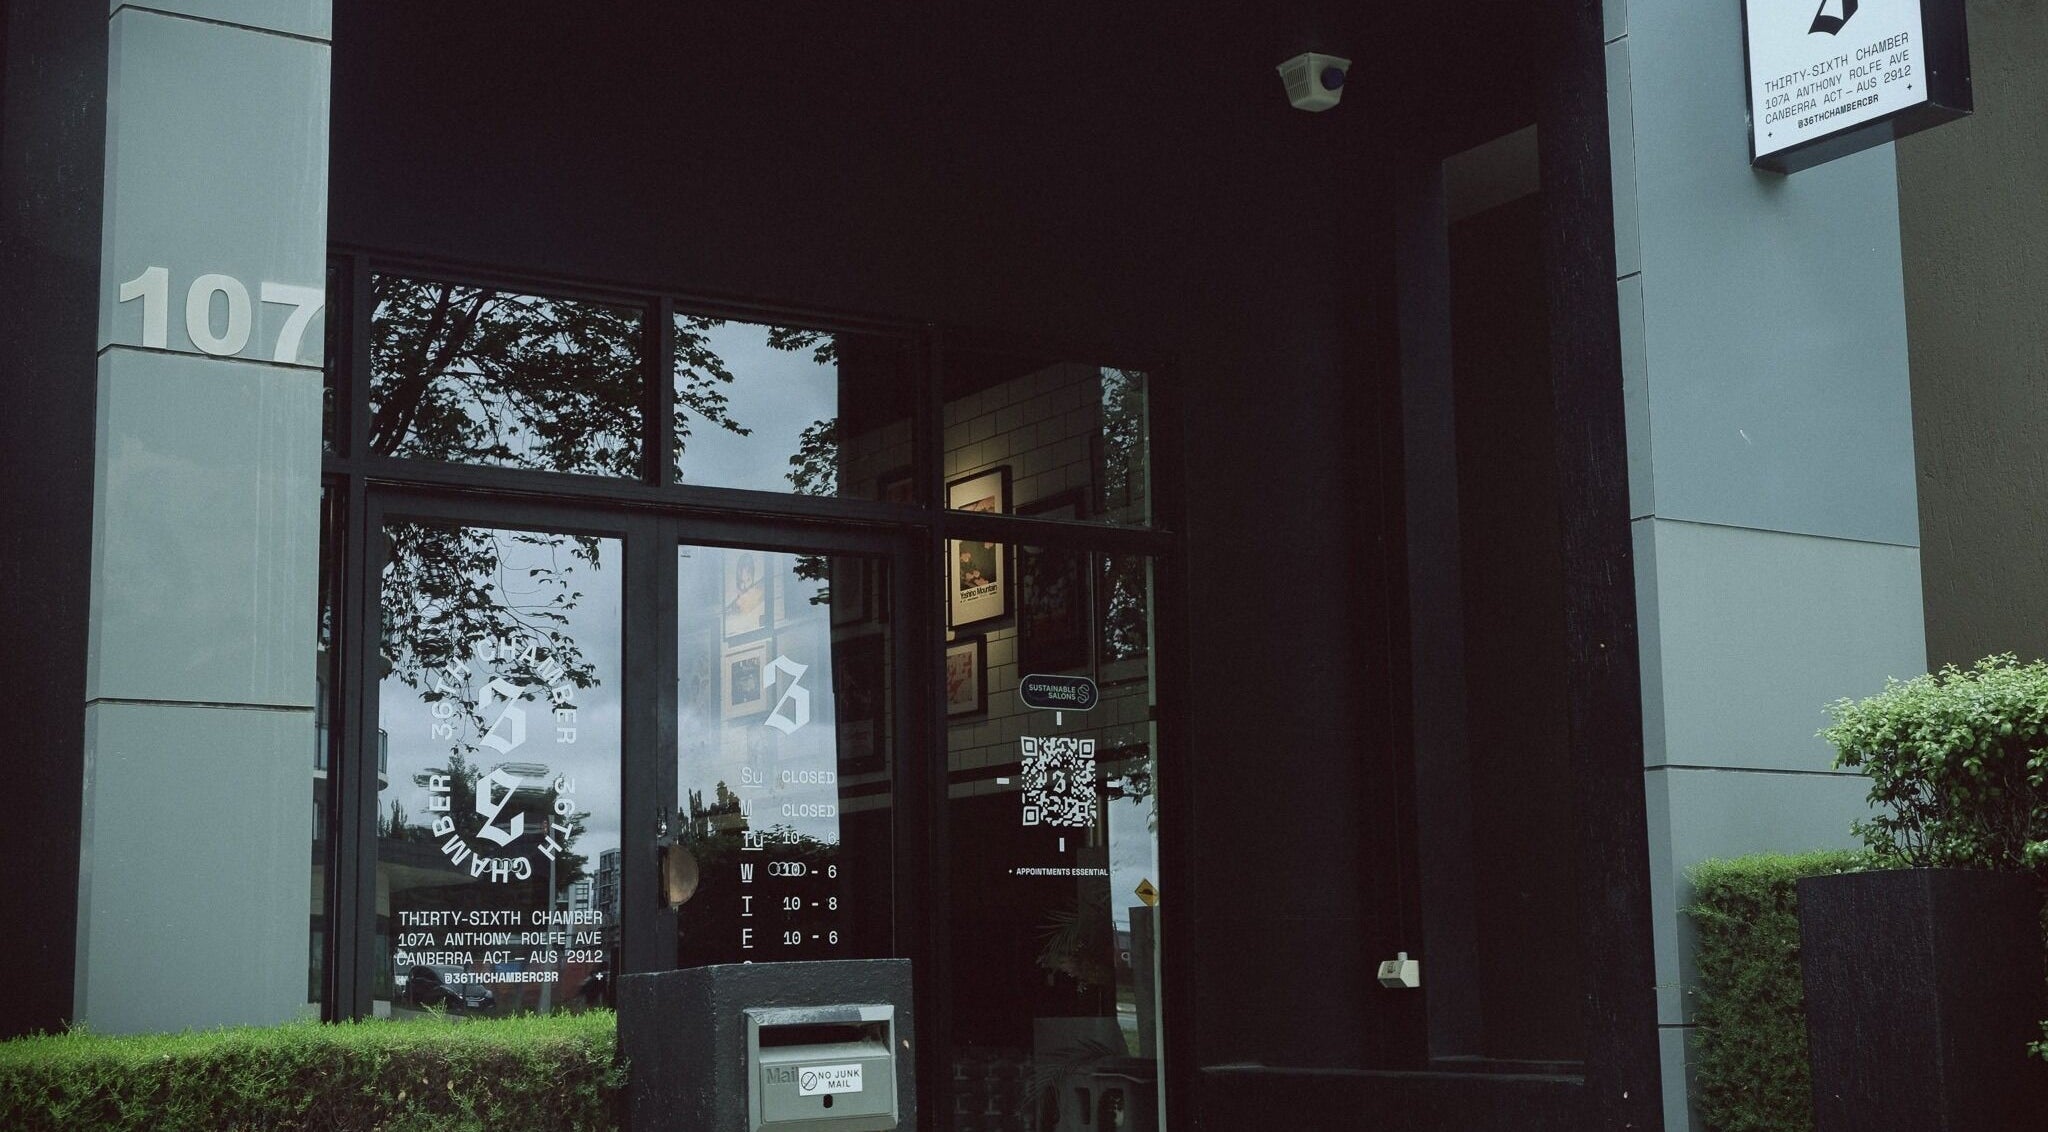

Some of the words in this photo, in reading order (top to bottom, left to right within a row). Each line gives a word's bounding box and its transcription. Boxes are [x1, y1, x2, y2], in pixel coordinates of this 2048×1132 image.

[1764, 54, 1848, 93] THIRTY-SIXTH
[1855, 32, 1909, 61] CHAMBER
[1765, 94, 1790, 110] 107A
[1796, 74, 1842, 99] ANTHONY
[1849, 60, 1882, 80] ROLFE
[1889, 50, 1909, 67] AVE
[1765, 99, 1817, 125] CANBERRA
[1823, 90, 1842, 104] ACT
[1856, 77, 1877, 93] AUS
[1884, 65, 1911, 84] 2912
[1798, 94, 1879, 129] @36THCHAMBERCBR
[119, 266, 325, 363] 107
[477, 636, 578, 745] CHAMBER
[1028, 684, 1076, 694] SUSTAINABLE
[1047, 691, 1076, 701] SALONS
[741, 766, 763, 784] Su
[781, 770, 835, 784] CLOSED
[741, 799, 753, 816] M
[781, 804, 836, 818] CLOSED
[429, 773, 532, 884] CHAMBER
[741, 830, 764, 848] Tu
[782, 831, 800, 845] 10
[740, 863, 753, 880] W
[828, 865, 837, 879] 6
[1016, 868, 1071, 876] APPOINTMENTS
[1071, 868, 1108, 876] ESSENTIAL
[742, 896, 753, 913] T
[783, 897, 801, 911] 10
[828, 897, 838, 911] 8
[399, 910, 521, 926] THIRTY-SIXTH
[532, 910, 603, 926] CHAMBER
[398, 933, 435, 947] 107A
[444, 932, 511, 946] ANTHONY
[521, 932, 566, 945] ROLFE
[575, 931, 602, 945] AVE
[742, 928, 753, 945] F
[783, 931, 801, 945] 10
[829, 931, 838, 945] 6
[397, 951, 473, 966] CANBERRA
[482, 951, 511, 964] ACT
[529, 950, 558, 963] AUS
[566, 949, 603, 963] 2912
[444, 972, 558, 984] @36THCHAMBERCBR
[767, 1066, 800, 1085] Mail
[818, 1071, 832, 1080] NO
[834, 1069, 860, 1079] JUNK
[828, 1080, 851, 1089] MAIL
